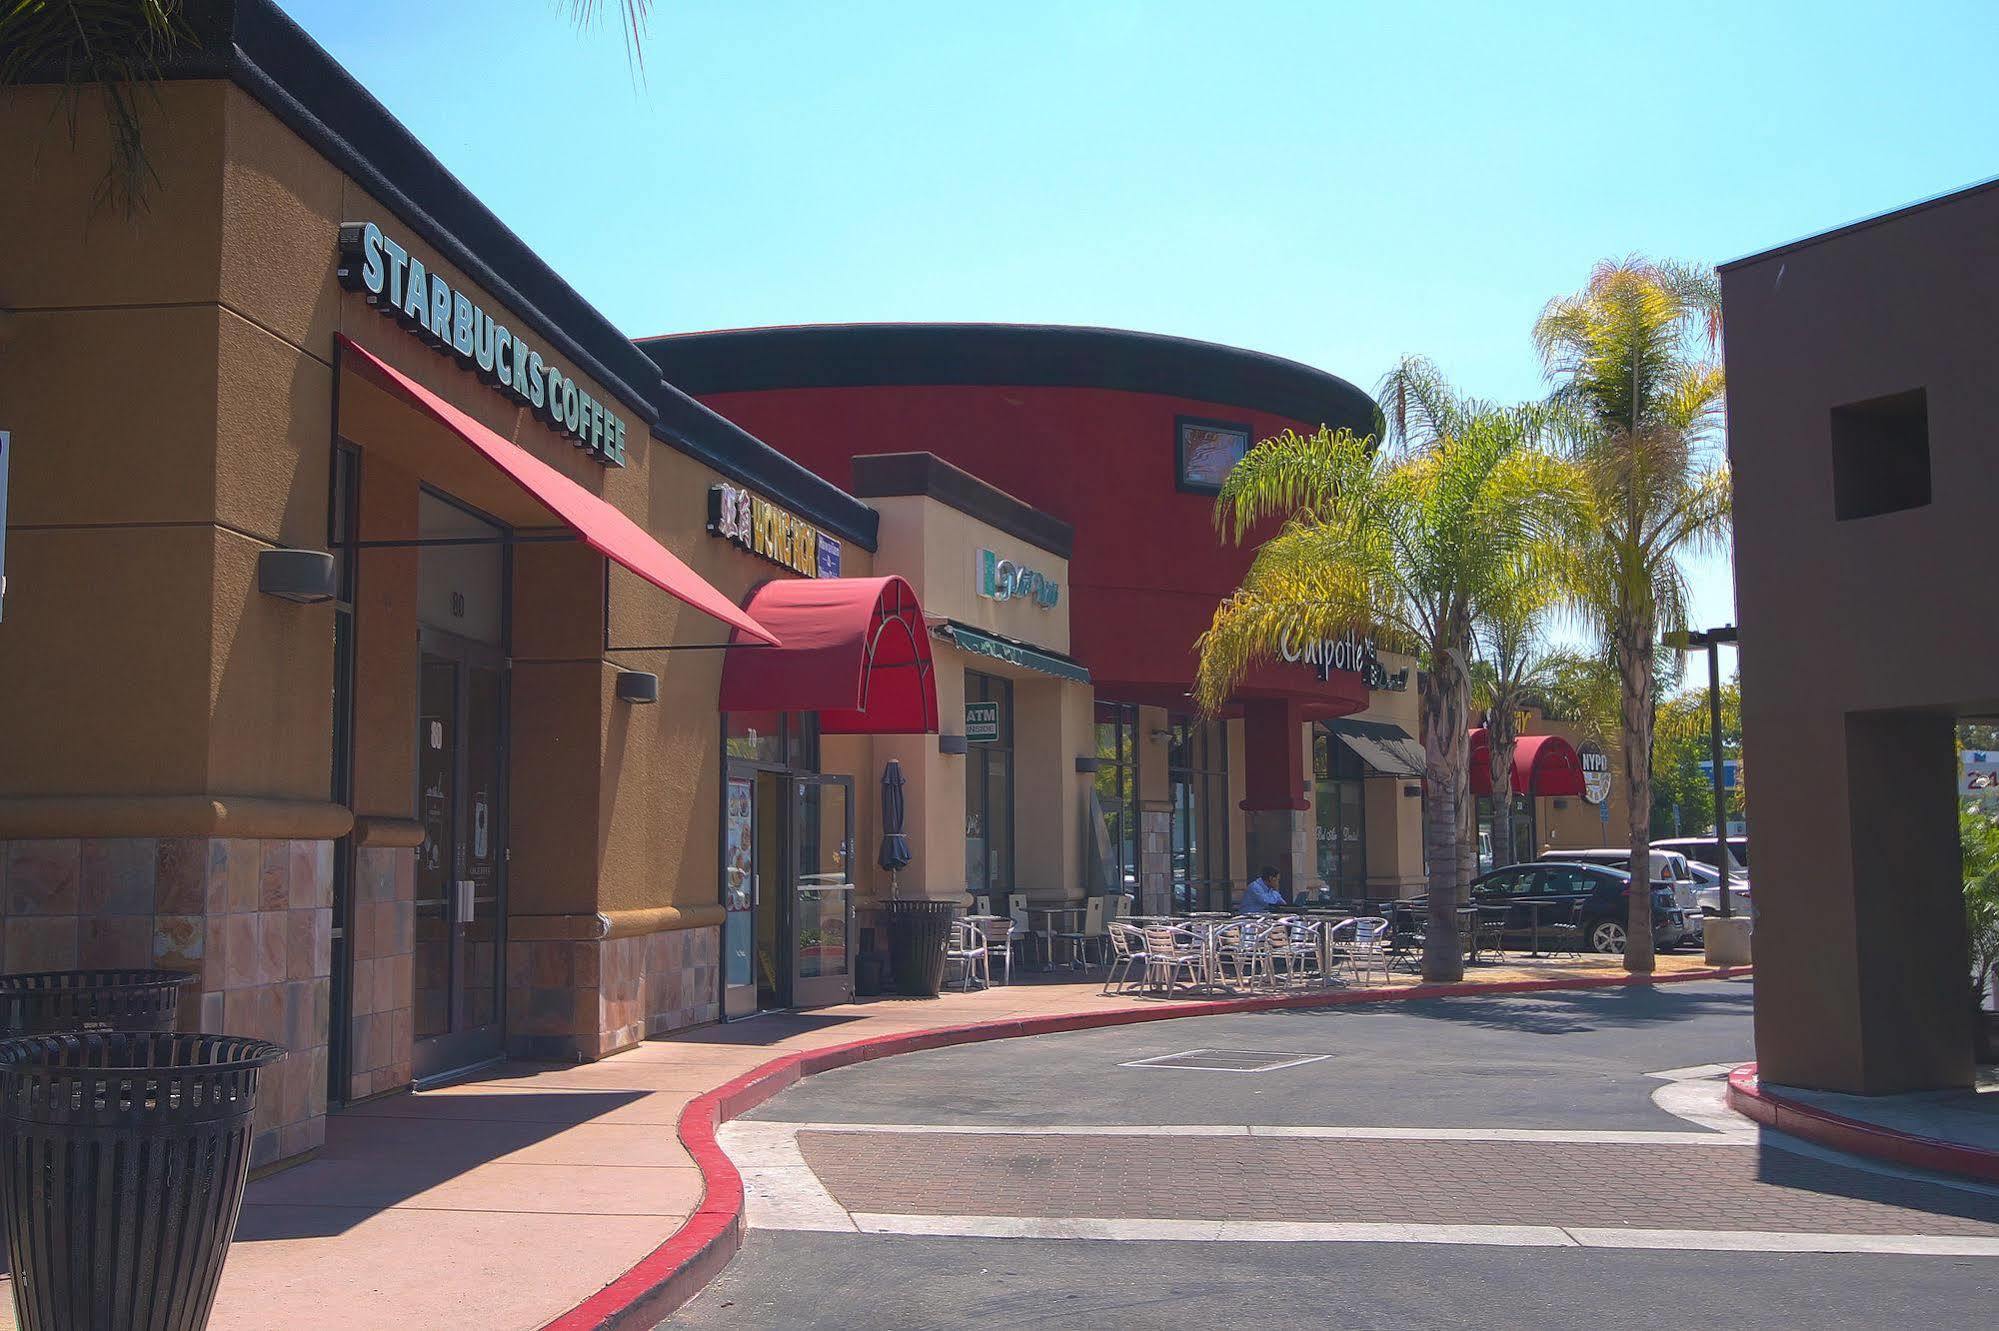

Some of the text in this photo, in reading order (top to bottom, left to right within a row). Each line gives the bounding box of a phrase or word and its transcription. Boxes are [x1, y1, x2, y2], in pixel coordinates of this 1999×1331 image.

[362, 222, 627, 468] STARBUCKS COFFEE
[966, 709, 996, 722] ATM
